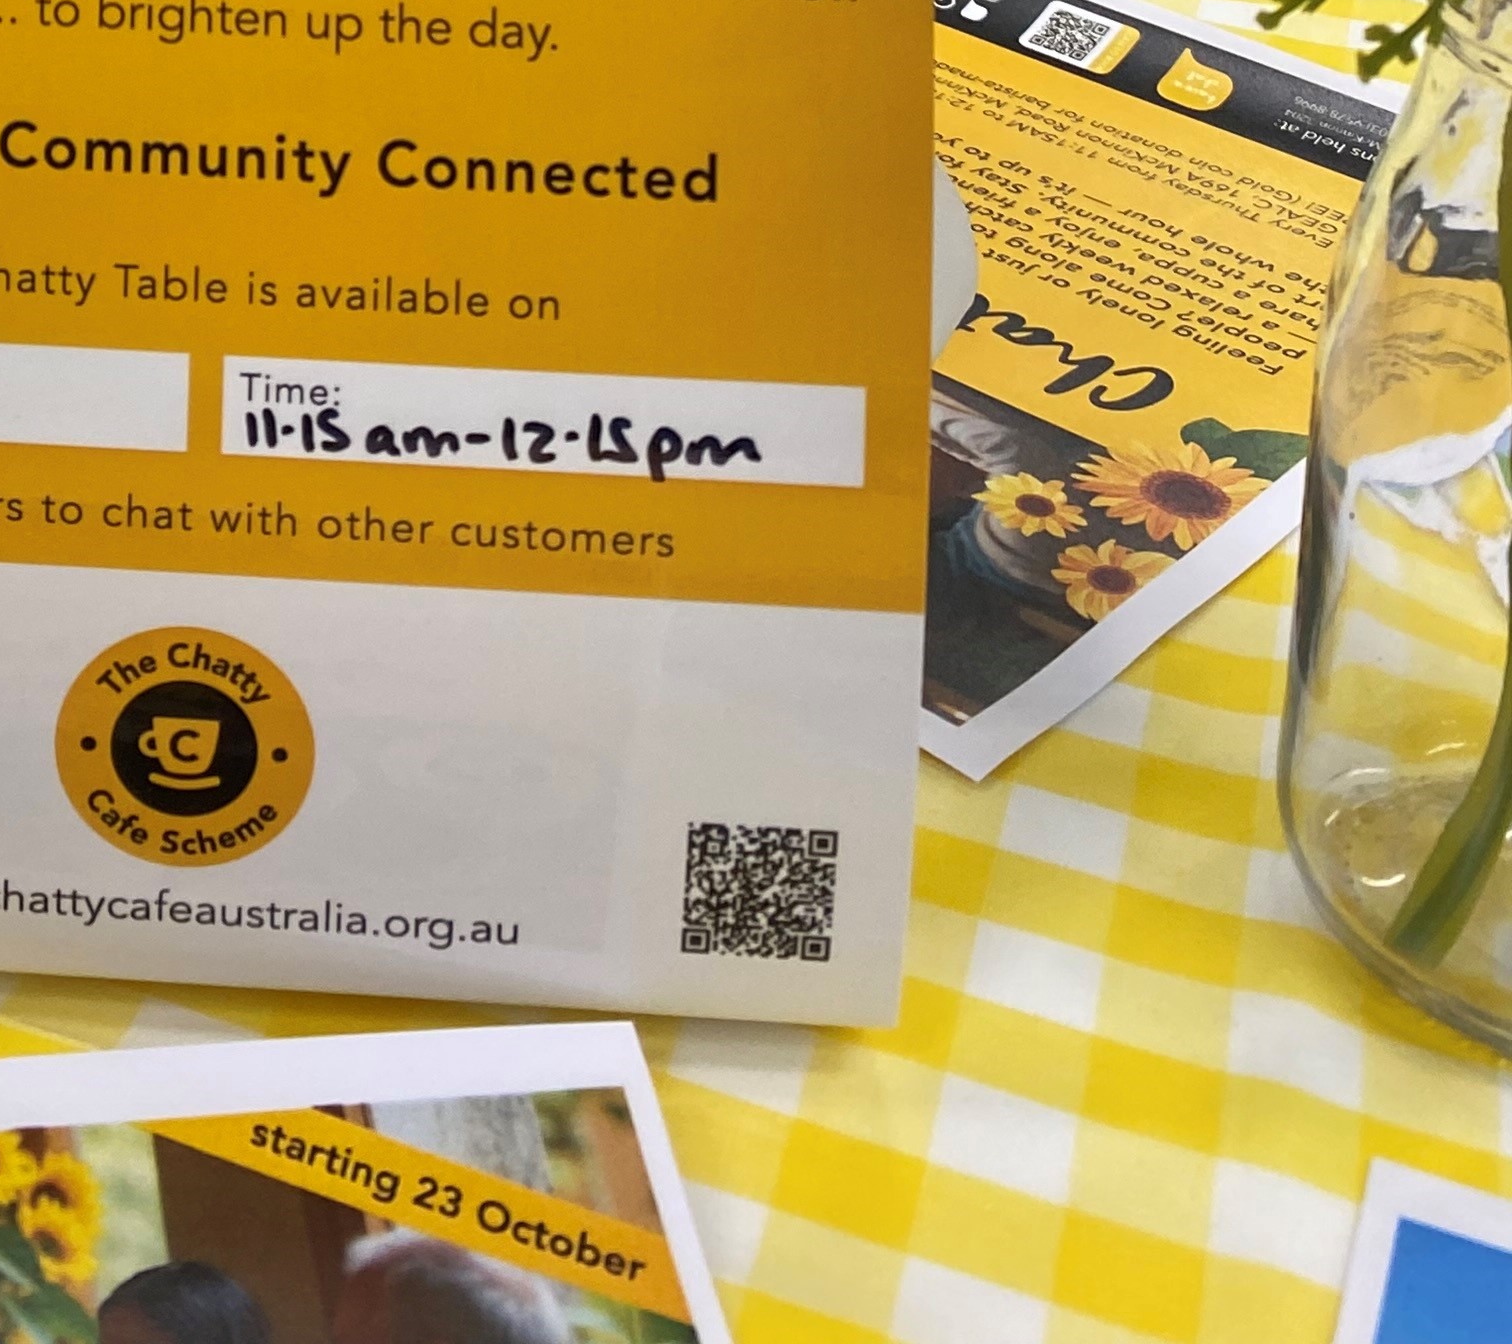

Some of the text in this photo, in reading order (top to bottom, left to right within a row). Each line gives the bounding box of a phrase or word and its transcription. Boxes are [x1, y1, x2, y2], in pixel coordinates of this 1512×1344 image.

[305, 11, 364, 54] up
[380, 3, 452, 45] the
[469, 7, 559, 63] day.
[931, 72, 1008, 108] McKinn
[931, 56, 1301, 204] (Gold coin donation for barista-mad
[982, 109, 1004, 121] to
[1014, 105, 1071, 132] Road,
[1005, 119, 1097, 158] 11:15AM
[1074, 129, 1180, 175] McKinnon
[1300, 130, 1346, 153] held
[378, 138, 719, 203] Connected
[1106, 156, 1157, 181] from
[1187, 170, 1239, 197] 169A
[963, 146, 1333, 294] the whole hour it's up to
[1023, 206, 1042, 216] a
[1161, 177, 1260, 222] Thursday
[969, 166, 1285, 293] of the community. Stay
[1044, 215, 1121, 248] enjoy
[1268, 218, 1334, 249] Every
[1038, 232, 1135, 276] weekly
[1132, 247, 1225, 289] cuppa,
[113, 262, 228, 303] Table
[246, 271, 278, 307] is
[295, 276, 491, 319] available
[508, 292, 560, 322] on
[970, 223, 1307, 359] people? Come along to
[980, 247, 1284, 375] Feeling lonely or just
[1139, 274, 1254, 320] relaxed
[1232, 289, 1251, 299] a
[1258, 300, 1320, 331] hare
[1260, 319, 1280, 330] a
[239, 372, 342, 407] Time:
[41, 493, 84, 526] to
[101, 495, 193, 533] chat
[210, 501, 298, 538] with
[317, 510, 434, 545] other
[450, 520, 676, 559] customers
[95, 641, 272, 708] The Chatty
[85, 787, 279, 857] Cafe Scheme
[249, 1122, 648, 1282] starting 23 October
